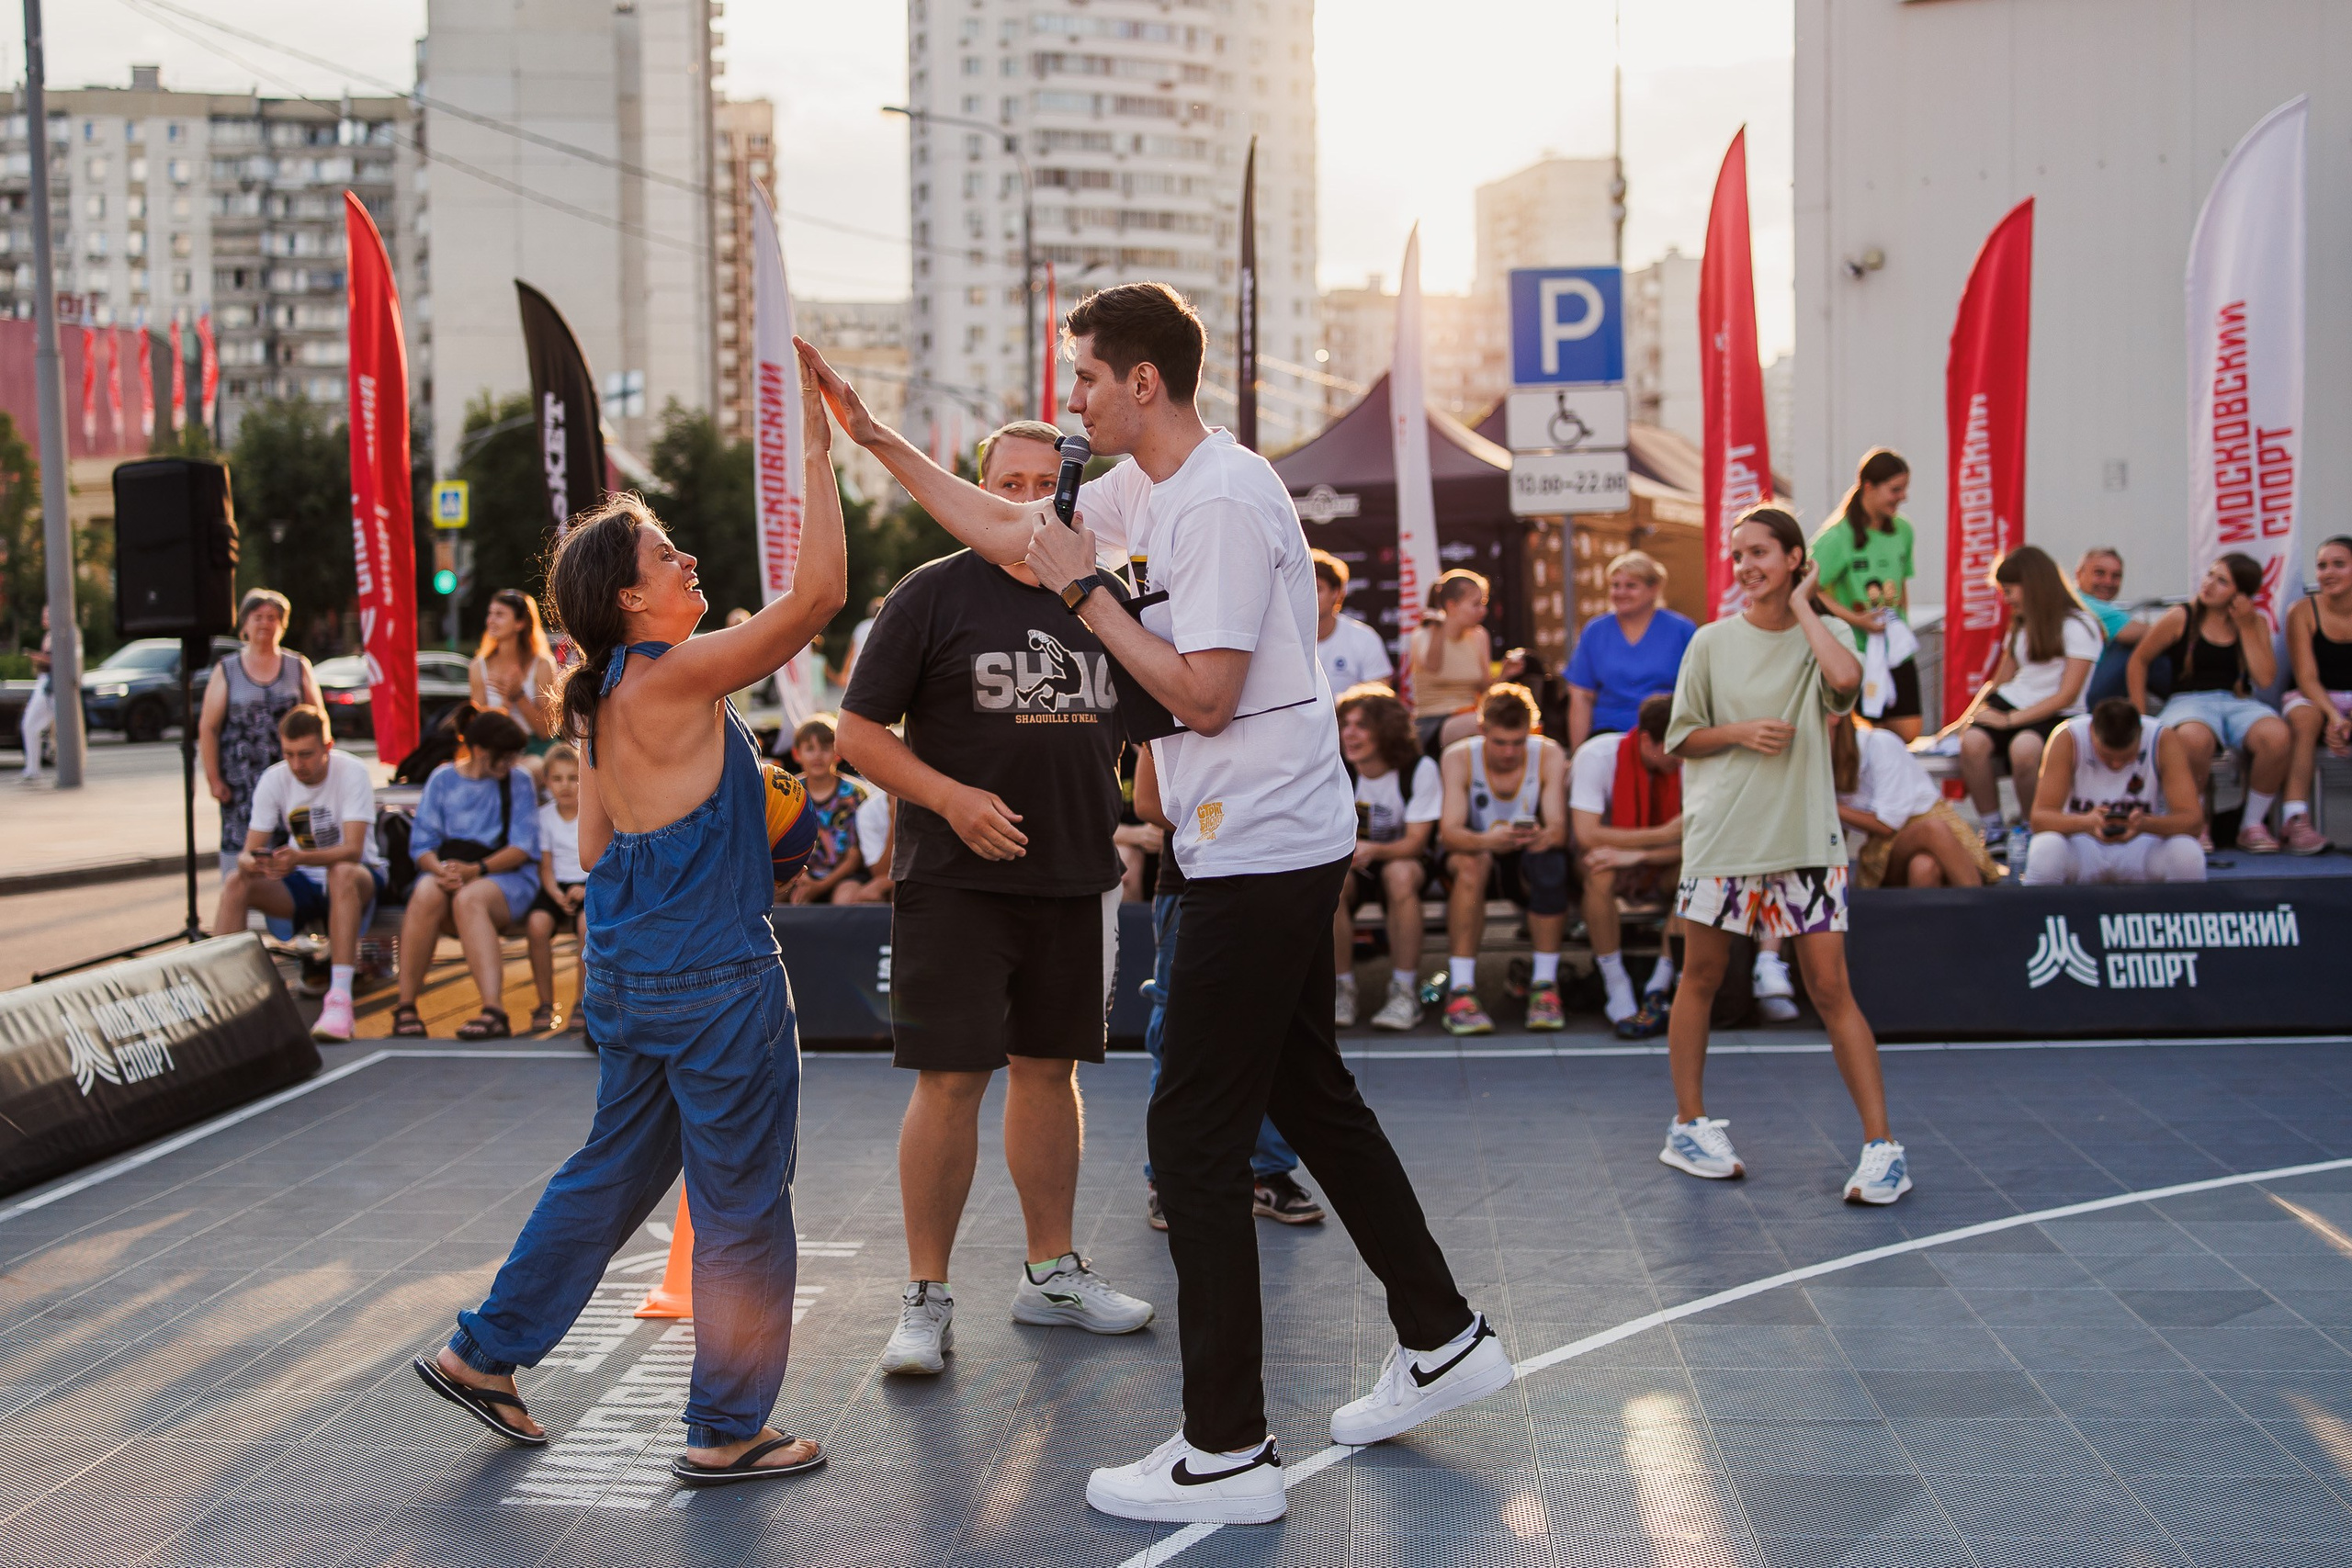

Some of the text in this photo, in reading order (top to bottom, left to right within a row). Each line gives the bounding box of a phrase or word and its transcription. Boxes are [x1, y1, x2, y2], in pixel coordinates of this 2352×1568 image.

[1540, 278, 1605, 376] P
[2256, 425, 2293, 538] СПОРТ
[1015, 714, 1098, 723] SHAQUILLE O'NEAL
[2099, 903, 2300, 949] МОСКОВСКИЙ
[2106, 952, 2199, 988] СПОРТ
[90, 975, 211, 1042] МОСКОВСКИЙ
[114, 1034, 175, 1084] СПОРТ
